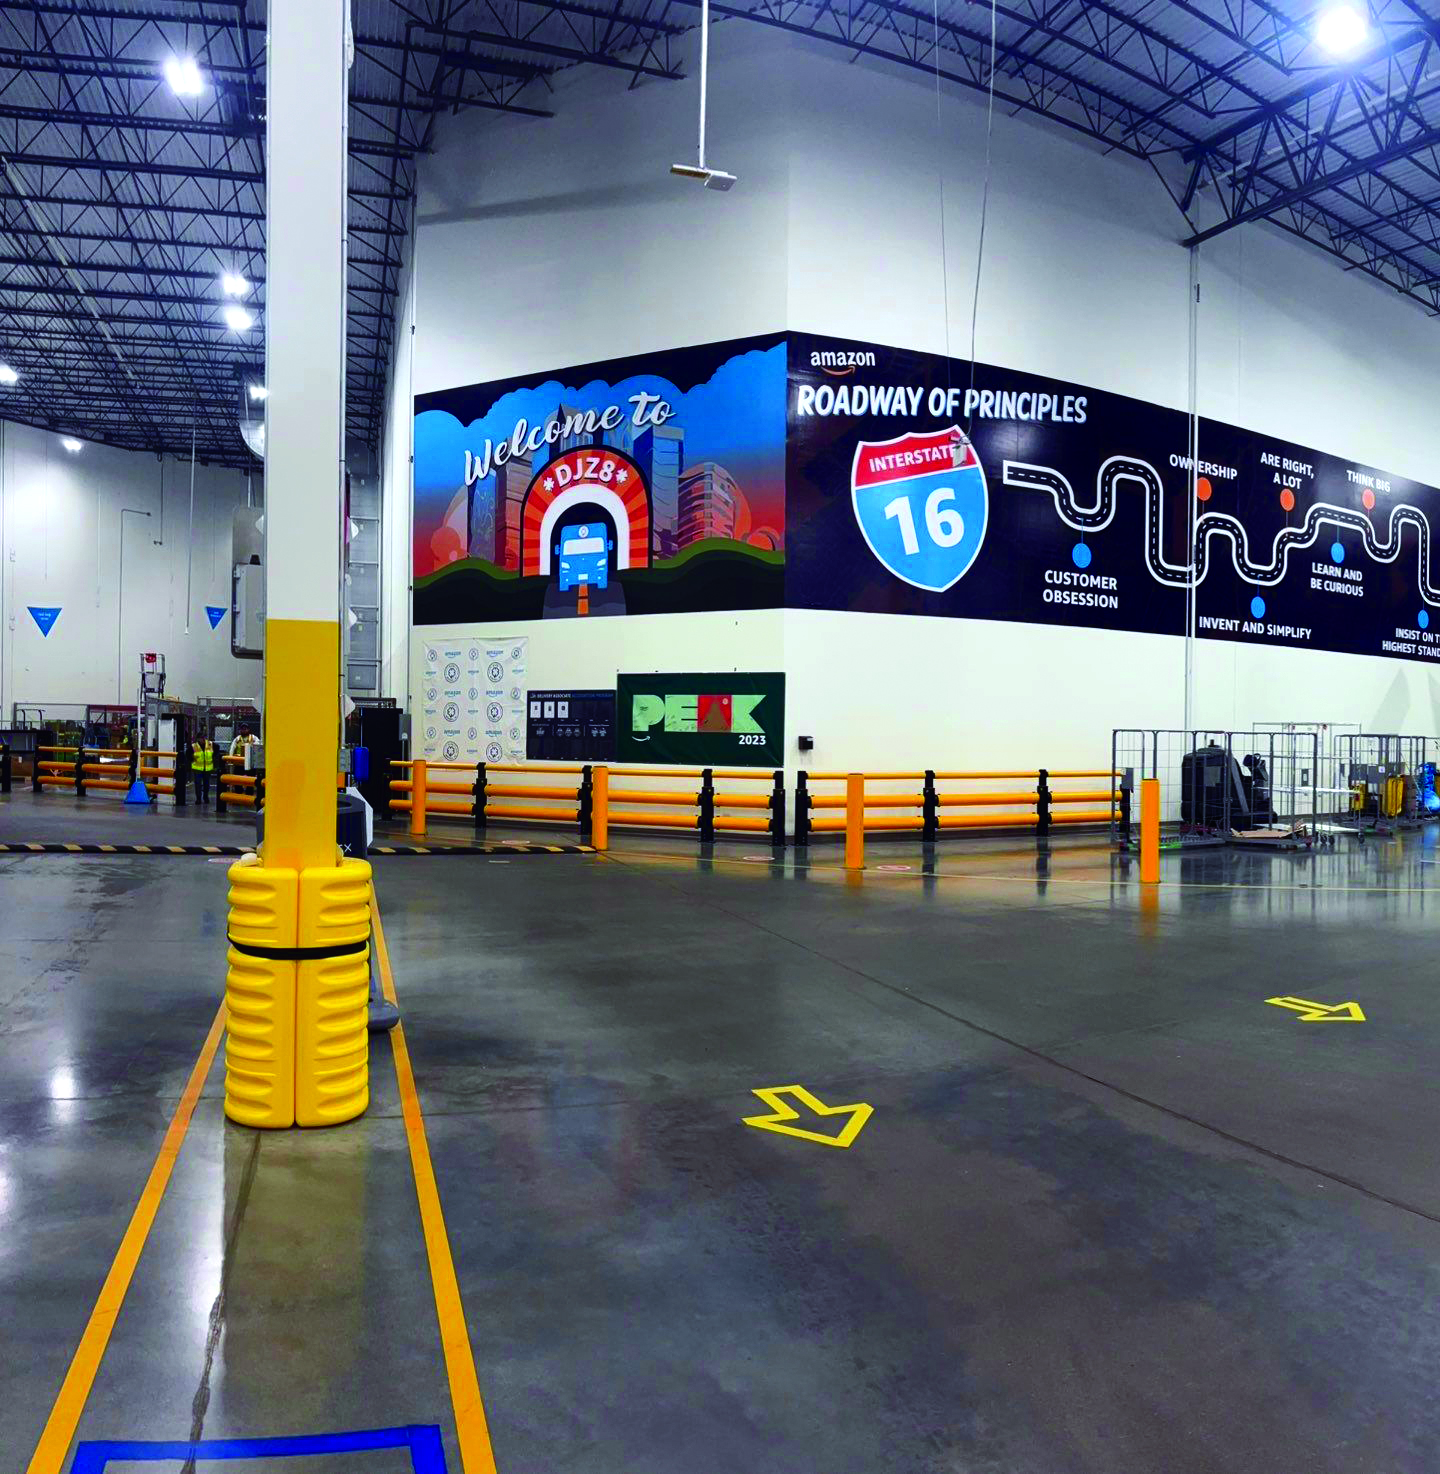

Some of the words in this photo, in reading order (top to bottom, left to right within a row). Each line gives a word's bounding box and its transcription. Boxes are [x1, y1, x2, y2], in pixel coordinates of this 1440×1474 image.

[810, 351, 875, 366] amazon
[796, 384, 924, 417] ROADWAY
[928, 387, 960, 418] OF
[964, 389, 1088, 424] PRINCIPLES
[464, 404, 624, 486] Welcome
[628, 392, 676, 426] to
[555, 456, 614, 488] DJZ8
[1169, 453, 1238, 480] OWNERSHIP
[1261, 452, 1280, 468] ARE
[1282, 458, 1314, 479] RIGHT,
[1274, 472, 1282, 485] A
[1284, 474, 1301, 489] LOT
[1347, 470, 1374, 487] THINK
[1376, 477, 1390, 492] BIG
[884, 486, 965, 556] 16
[1044, 569, 1118, 591] CUSTOMER
[1312, 561, 1341, 578] LEARN
[1343, 568, 1362, 581] AND
[1311, 577, 1322, 590] BE
[1324, 579, 1363, 596] CURIOUS
[1043, 588, 1119, 609] OBSESSION
[1199, 616, 1240, 633] INVENT
[1242, 621, 1264, 634] AND
[1267, 624, 1311, 640] SIMPLIFY
[1395, 628, 1420, 641] INSIST
[1422, 632, 1433, 643] ON
[1382, 640, 1416, 655] HIGHEST
[632, 695, 767, 733] PEAK
[739, 735, 767, 745] 2023
